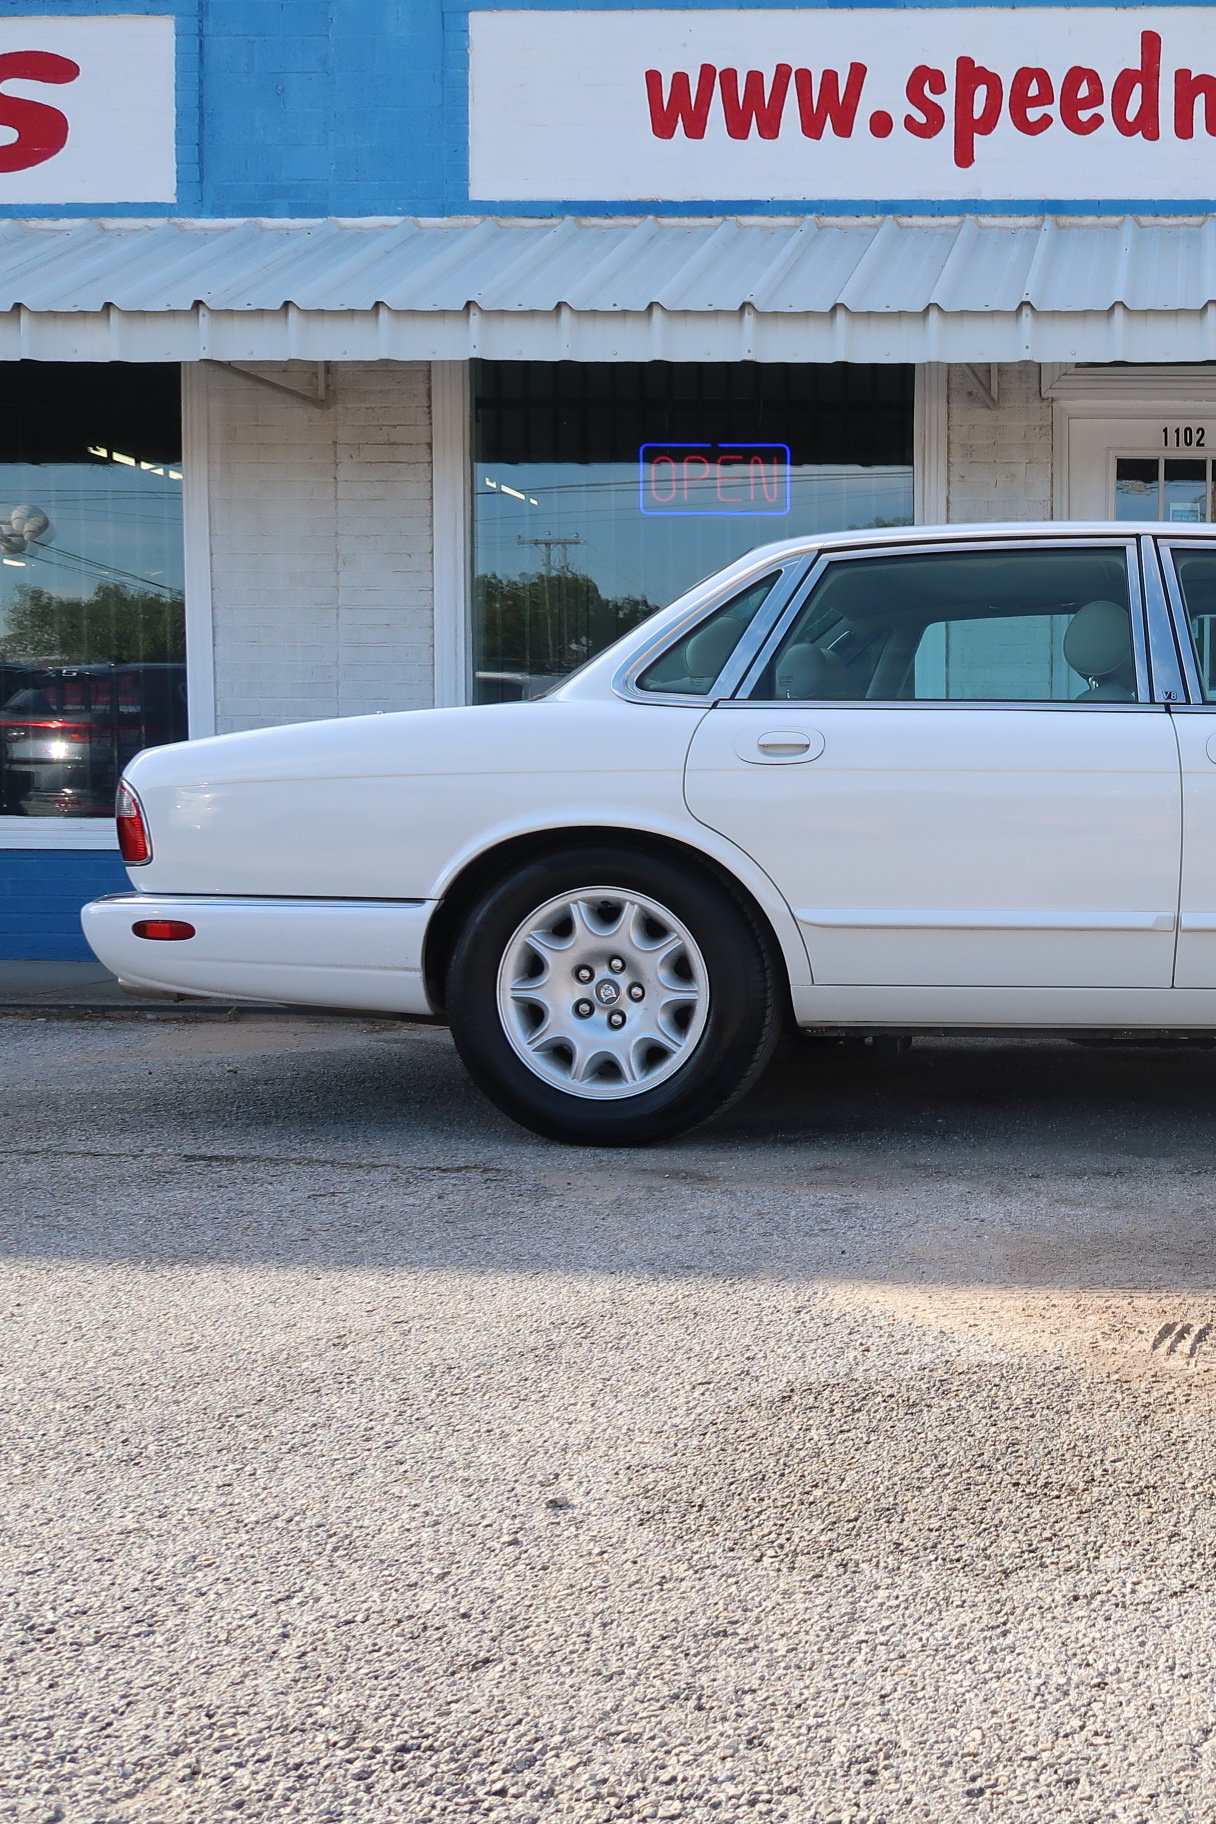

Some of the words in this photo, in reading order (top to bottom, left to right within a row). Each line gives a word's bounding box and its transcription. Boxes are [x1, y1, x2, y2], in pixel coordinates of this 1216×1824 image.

[1162, 426, 1206, 448] 1102
[651, 456, 779, 503] OPEN
[1162, 690, 1178, 701] V8
